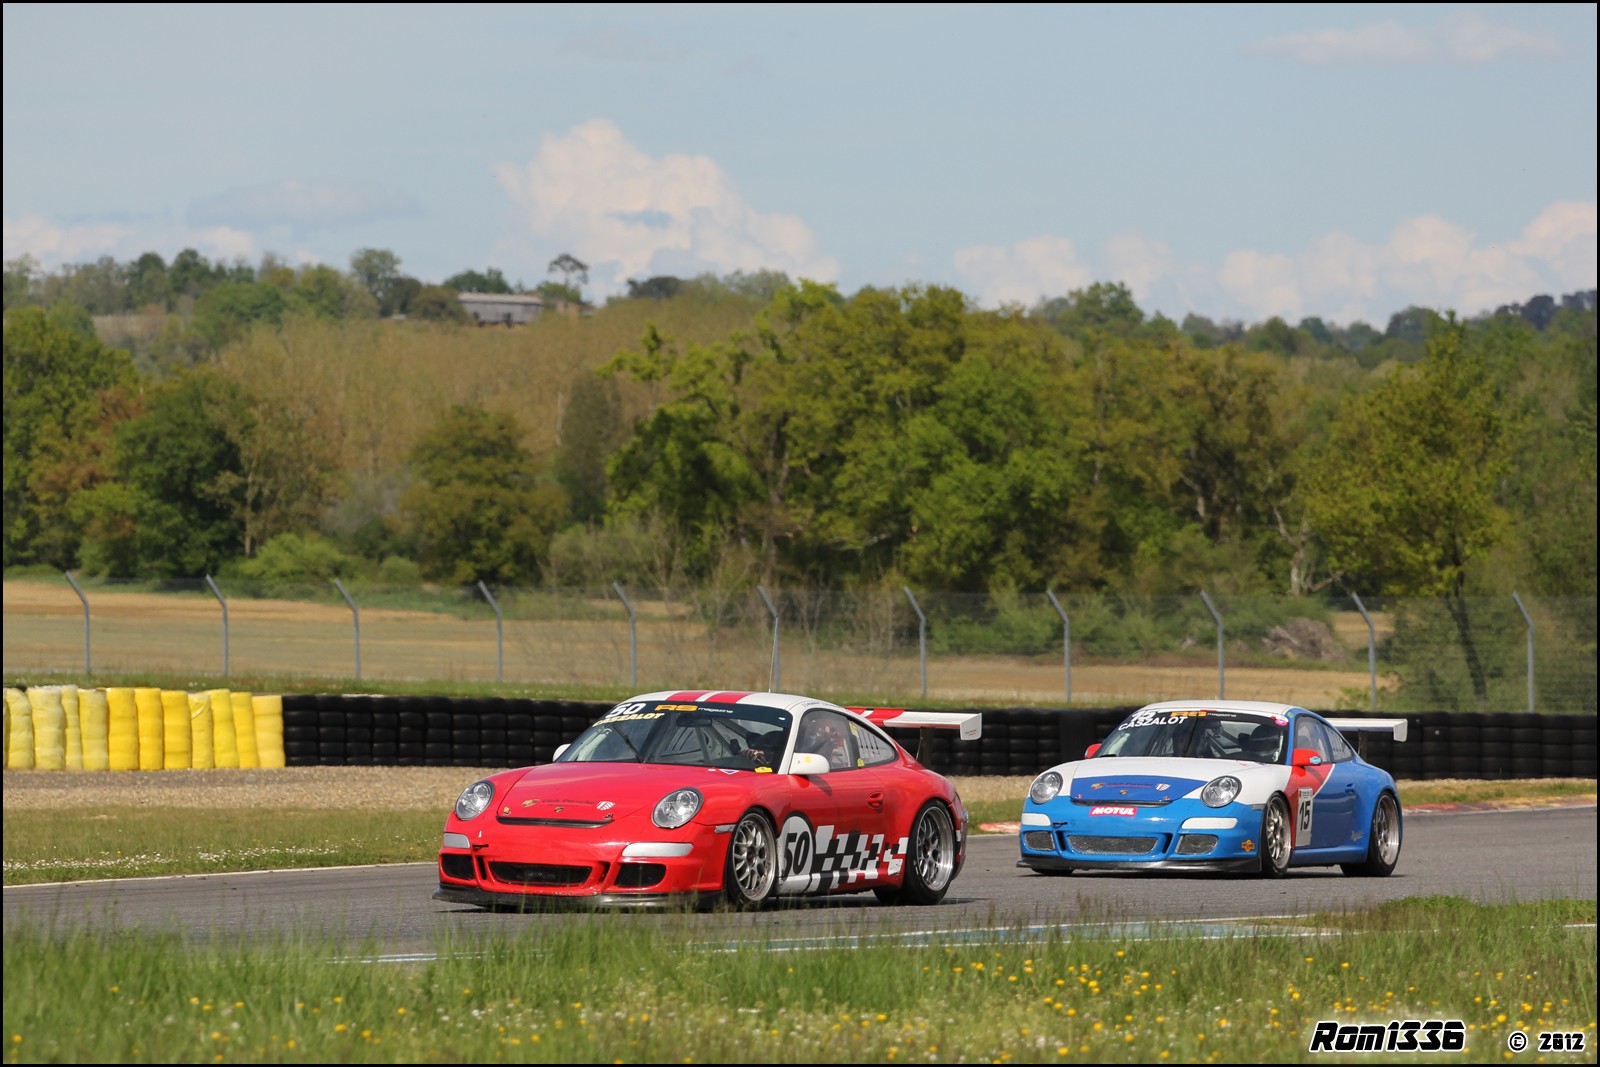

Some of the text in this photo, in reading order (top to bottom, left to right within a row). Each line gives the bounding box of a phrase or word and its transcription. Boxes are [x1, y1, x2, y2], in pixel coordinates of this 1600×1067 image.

[604, 702, 646, 719] 50
[655, 704, 698, 712] RS
[1118, 716, 1188, 730] CASZALOT
[1091, 806, 1135, 816] MOTUL
[1299, 800, 1311, 831] 15
[781, 831, 810, 881] 50
